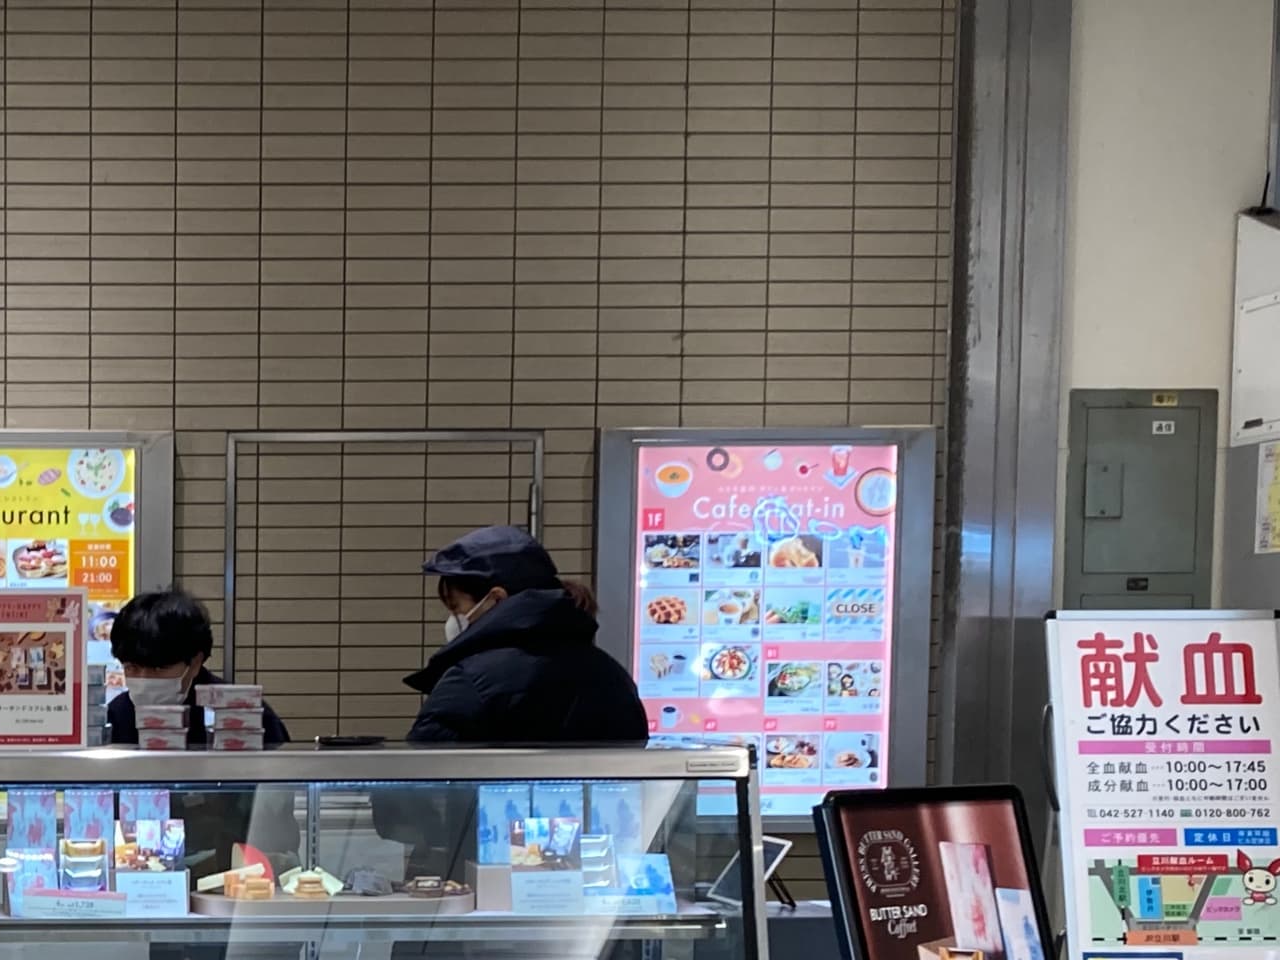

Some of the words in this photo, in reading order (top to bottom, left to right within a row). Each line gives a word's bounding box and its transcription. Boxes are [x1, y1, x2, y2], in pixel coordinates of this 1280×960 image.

[647, 513, 663, 527] 1F
[81, 555, 118, 568] 11:00
[81, 572, 113, 584] 21:00
[835, 603, 876, 614] CLOSE
[1077, 632, 1263, 708] 献血
[1087, 713, 1260, 736] ご協力ください
[1145, 741, 1205, 754] 受付時間
[869, 906, 902, 921] BUTTER
[902, 903, 928, 919] SAND
